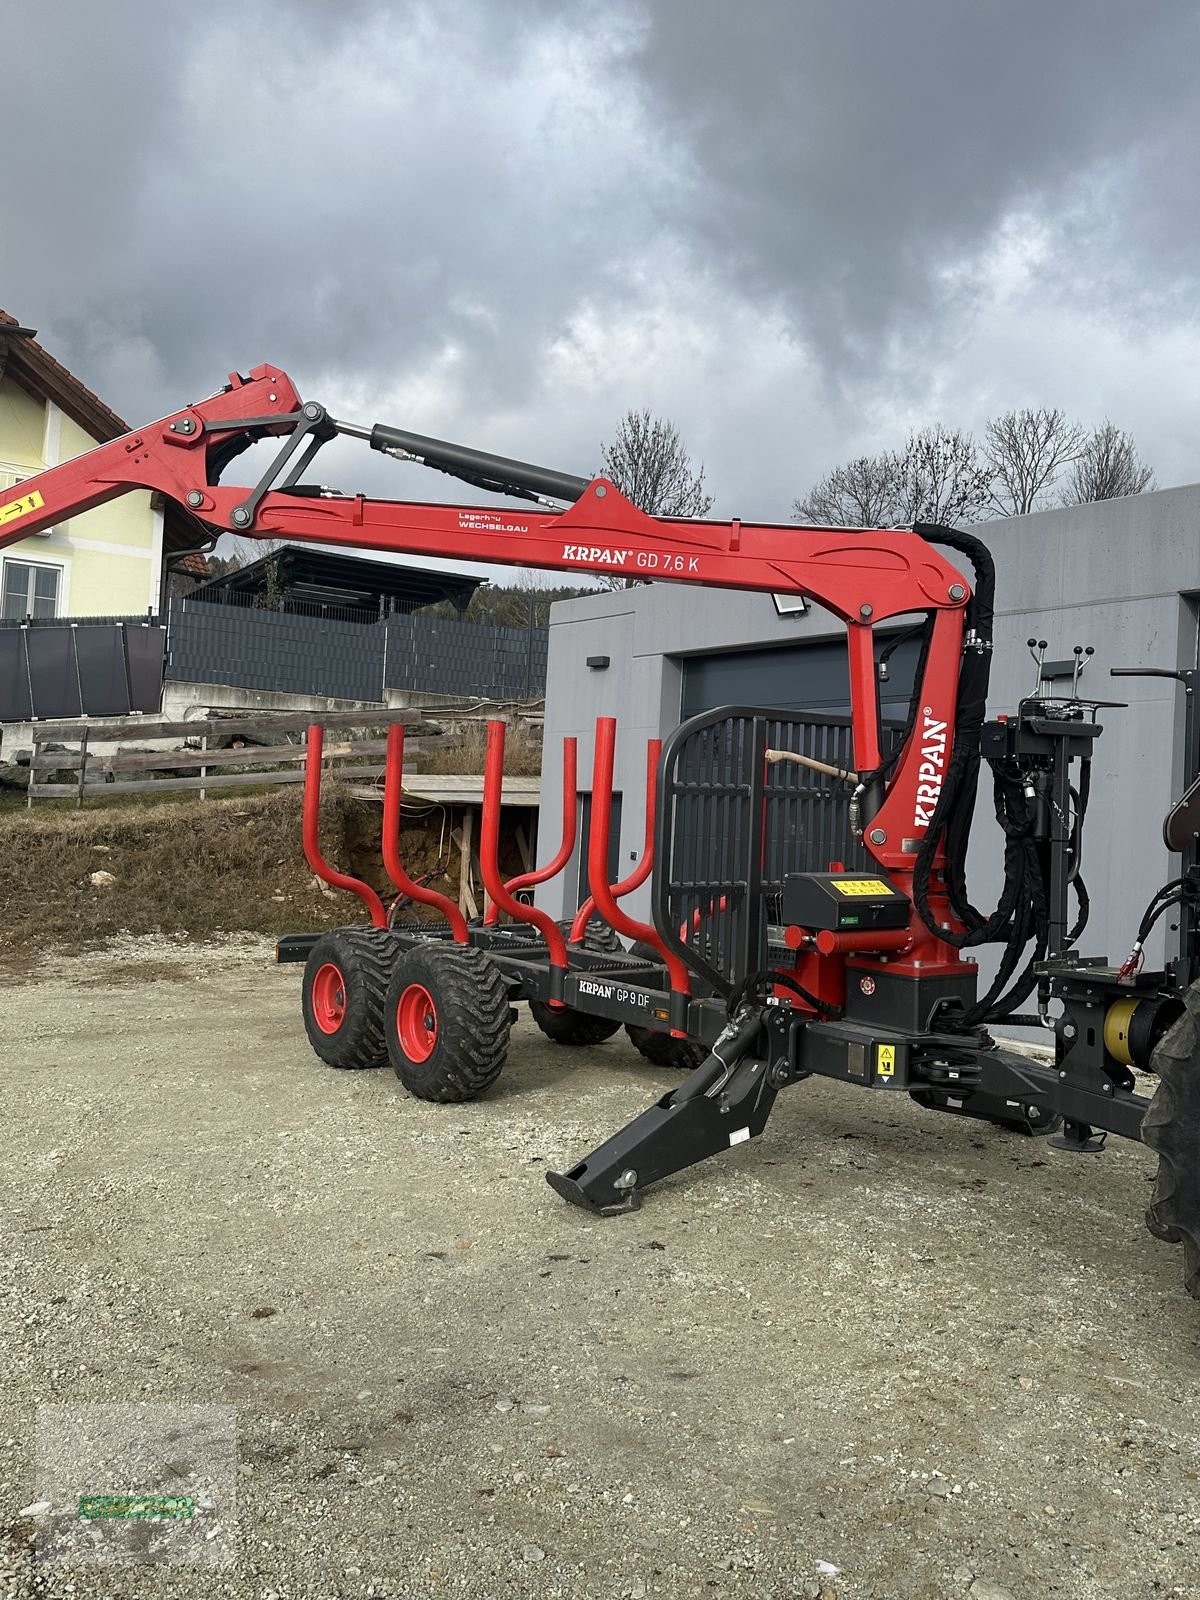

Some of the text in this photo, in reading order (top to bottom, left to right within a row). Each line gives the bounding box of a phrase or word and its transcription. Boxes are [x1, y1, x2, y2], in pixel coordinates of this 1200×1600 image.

[458, 521, 528, 532] WECHSELGAU
[637, 552, 658, 567] GD
[663, 555, 684, 571] 7,6
[688, 557, 699, 572] K
[617, 988, 628, 1002] GP
[630, 991, 635, 1005] 9
[638, 993, 650, 1007] DF
